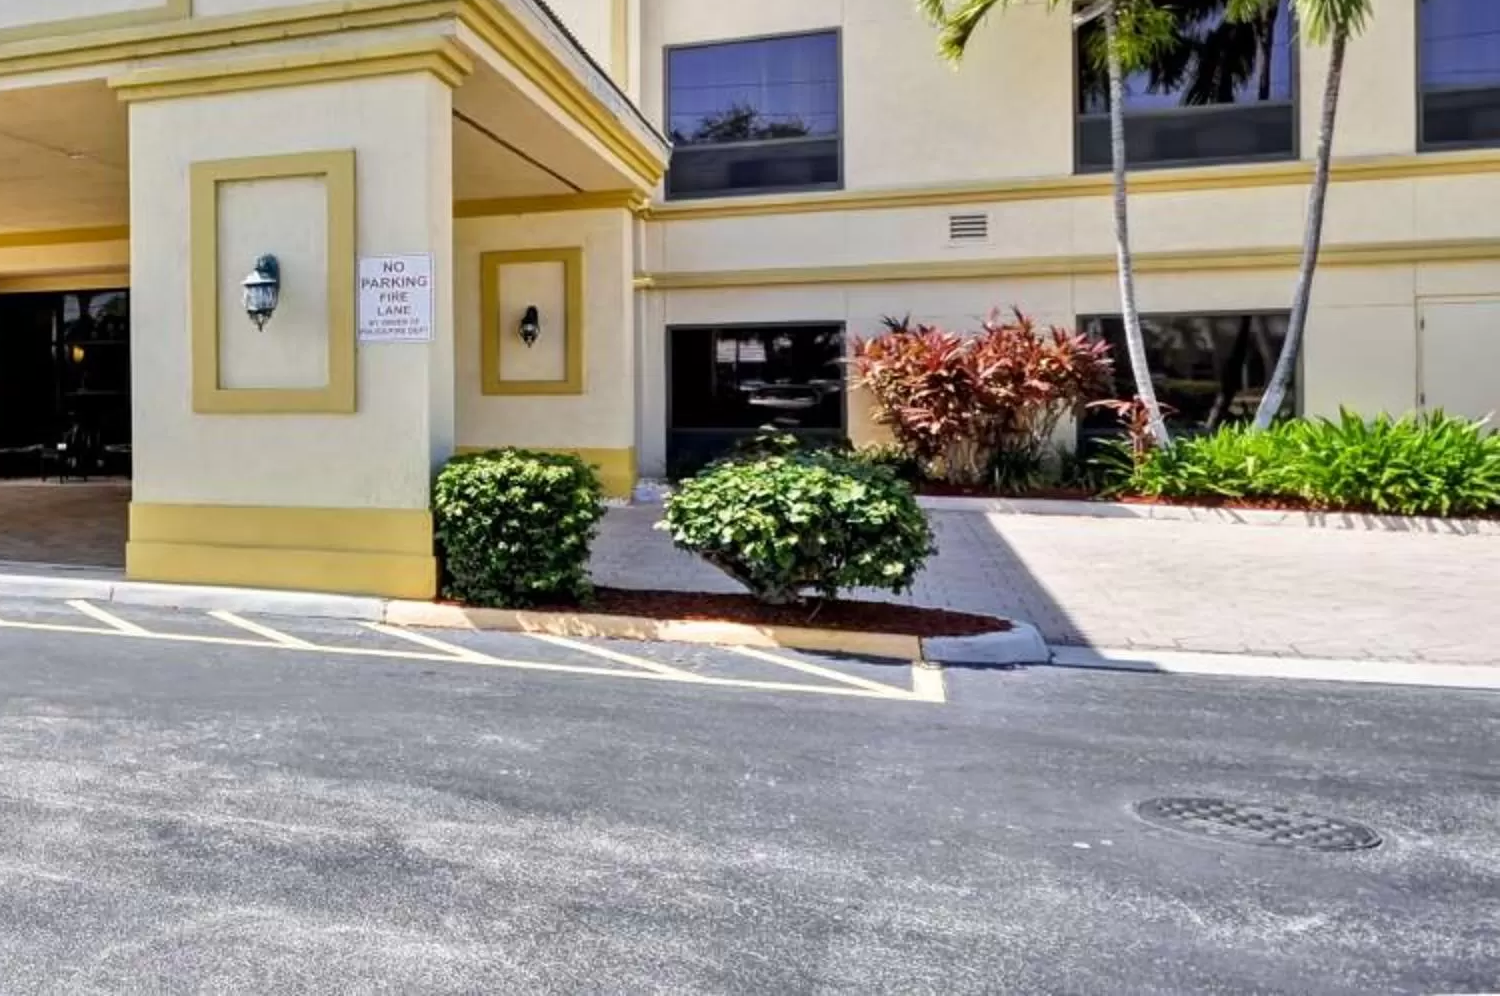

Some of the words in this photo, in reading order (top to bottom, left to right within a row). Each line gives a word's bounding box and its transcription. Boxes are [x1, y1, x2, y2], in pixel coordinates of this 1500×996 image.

[383, 260, 405, 273] NO
[361, 275, 429, 290] PARKING
[379, 291, 410, 303] FIRE
[377, 305, 412, 317] LANE
